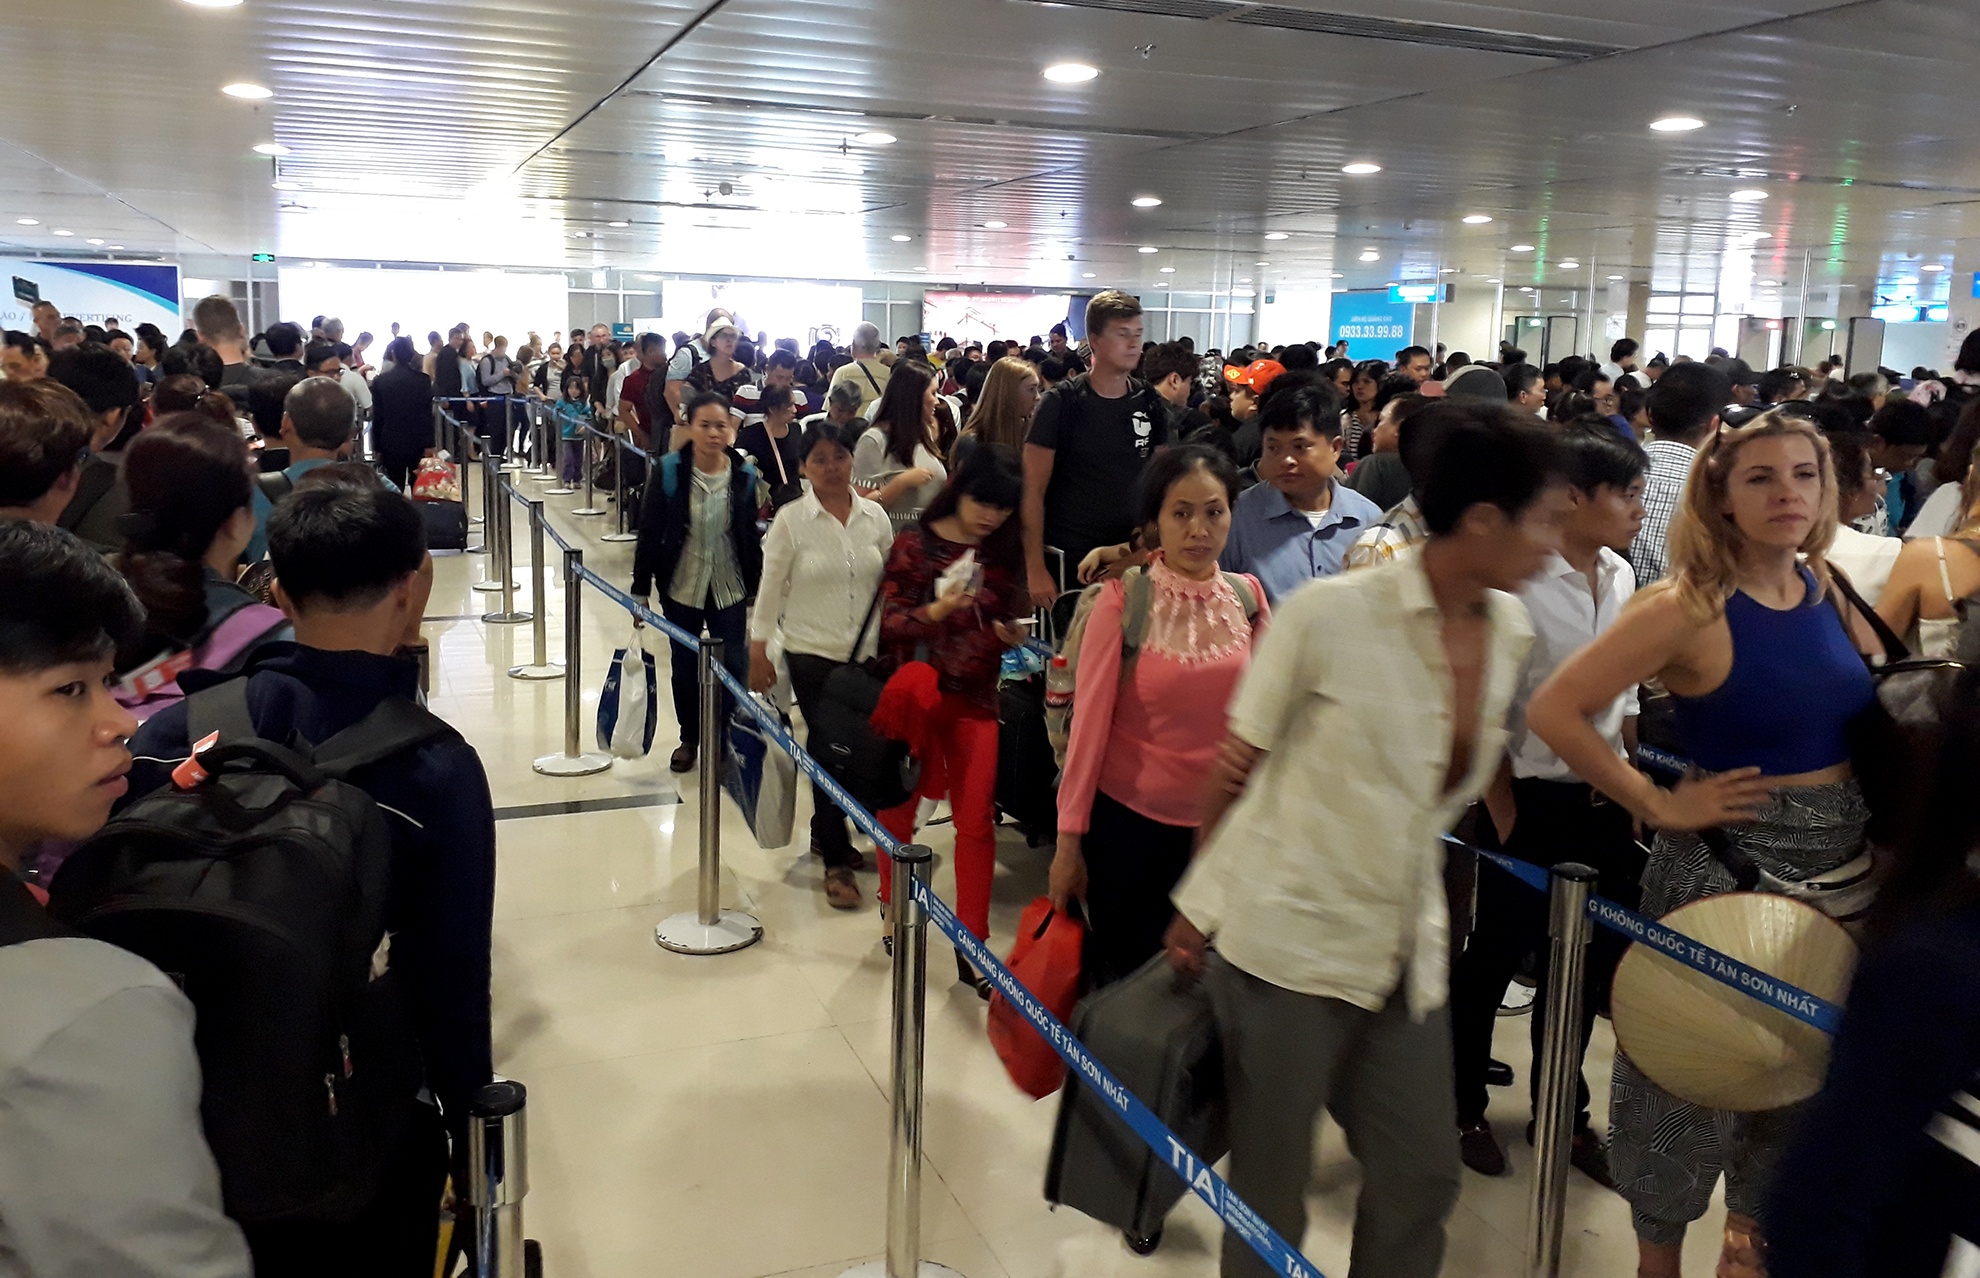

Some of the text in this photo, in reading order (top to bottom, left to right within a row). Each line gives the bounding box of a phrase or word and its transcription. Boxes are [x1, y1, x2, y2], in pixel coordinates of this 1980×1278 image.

[1339, 325, 1403, 338] 0933.33.99.88
[788, 739, 803, 765] TIA
[1600, 904, 1644, 935] KHÔNG
[1646, 928, 1685, 954] QUỐC
[1689, 946, 1707, 965] TẾ
[1740, 971, 1774, 997] SƠN
[1776, 988, 1819, 1017] NHẤT
[911, 876, 929, 911] IA
[998, 969, 1025, 1006] KHÔNG
[1025, 999, 1049, 1031] QUỐC
[1049, 1022, 1062, 1044] TẾ
[1081, 1054, 1102, 1086] SƠN
[1102, 1076, 1129, 1111] NHẤT
[1167, 1135, 1218, 1207] TIA
[1285, 1253, 1311, 1278] TA
